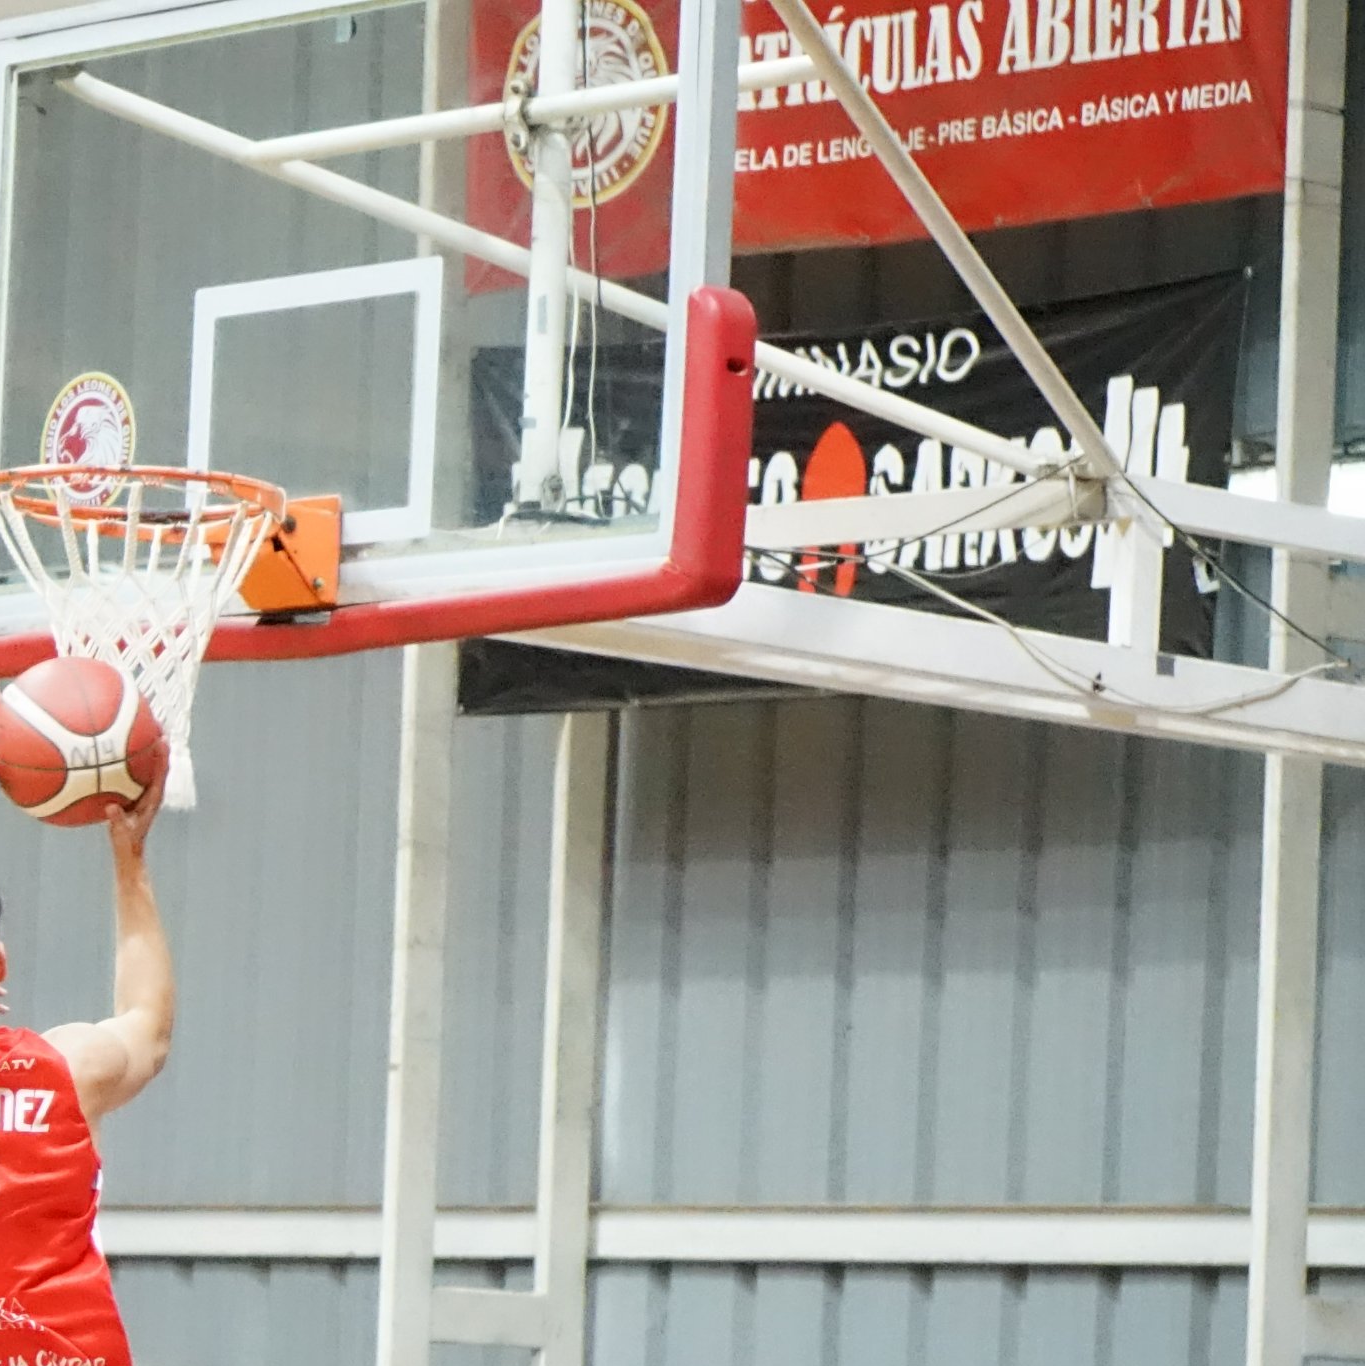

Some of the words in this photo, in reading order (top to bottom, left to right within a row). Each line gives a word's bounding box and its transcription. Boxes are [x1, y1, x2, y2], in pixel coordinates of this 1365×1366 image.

[782, 140, 813, 168] DE
[816, 124, 927, 164] LENGAJE
[937, 117, 976, 145] PRE
[981, 107, 1064, 140] BÁSICA
[1080, 86, 1161, 127] BÁSICA
[1164, 89, 1178, 114] Y
[1180, 78, 1253, 111] MEDIA
